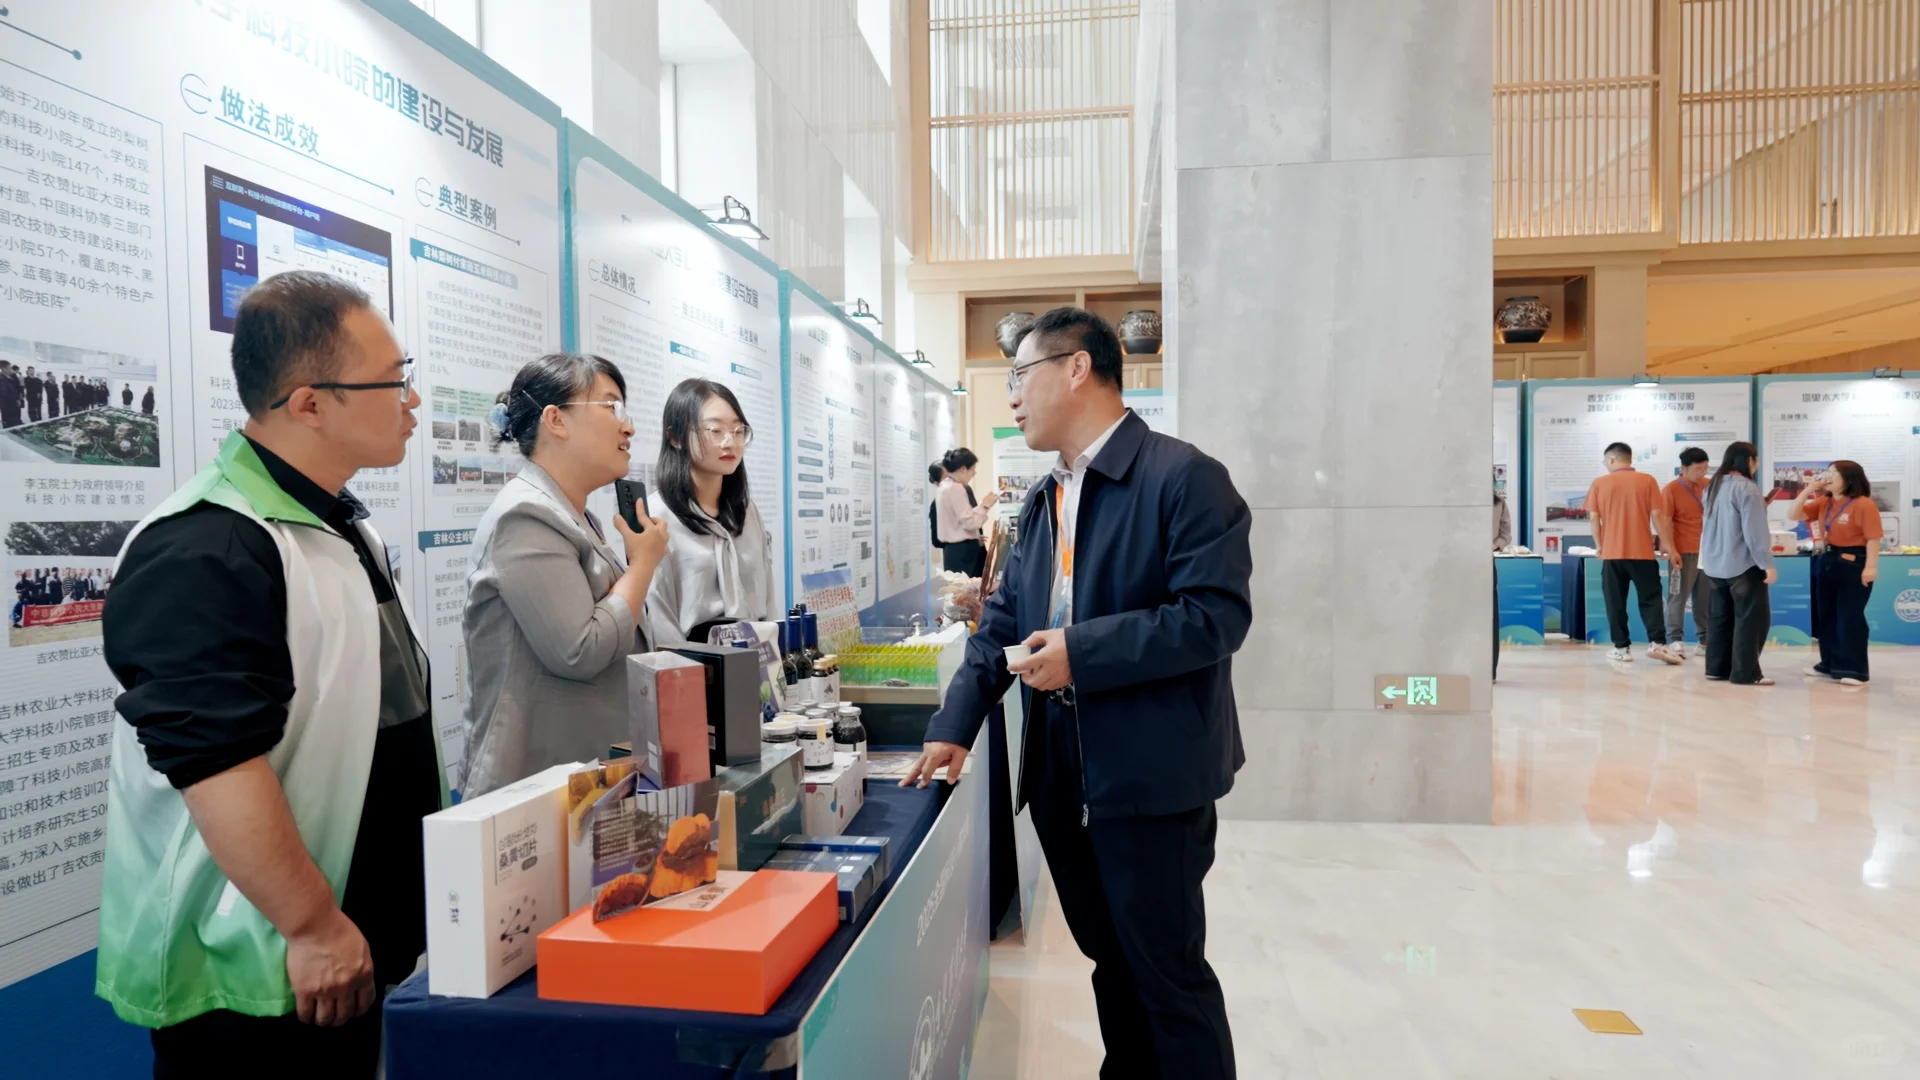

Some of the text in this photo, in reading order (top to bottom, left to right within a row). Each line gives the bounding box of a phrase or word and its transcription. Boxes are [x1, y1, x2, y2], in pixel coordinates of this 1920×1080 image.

[0, 84, 149, 151] 始于2009年成立的梨树
[219, 85, 320, 156] 做法成效
[0, 136, 150, 195] 科技小院147个，并成立
[0, 186, 152, 239] 村部、中国科协等三部门
[438, 184, 498, 231] 典型案例
[0, 208, 152, 260] 国农技协支持建设科技小
[0, 236, 153, 283] 小院57个，覆盖肉牛、黑
[601, 263, 637, 294] 总体情况
[212, 419, 250, 431] 二届科
[24, 478, 145, 492] 李玉院士为政府领导介绍
[25, 493, 145, 505] 科技小院建设情况
[36, 645, 104, 664] 吉农赞比亚大
[0, 733, 114, 771] 招生专项及改革
[0, 828, 107, 871] 篇，为深入实施乡
